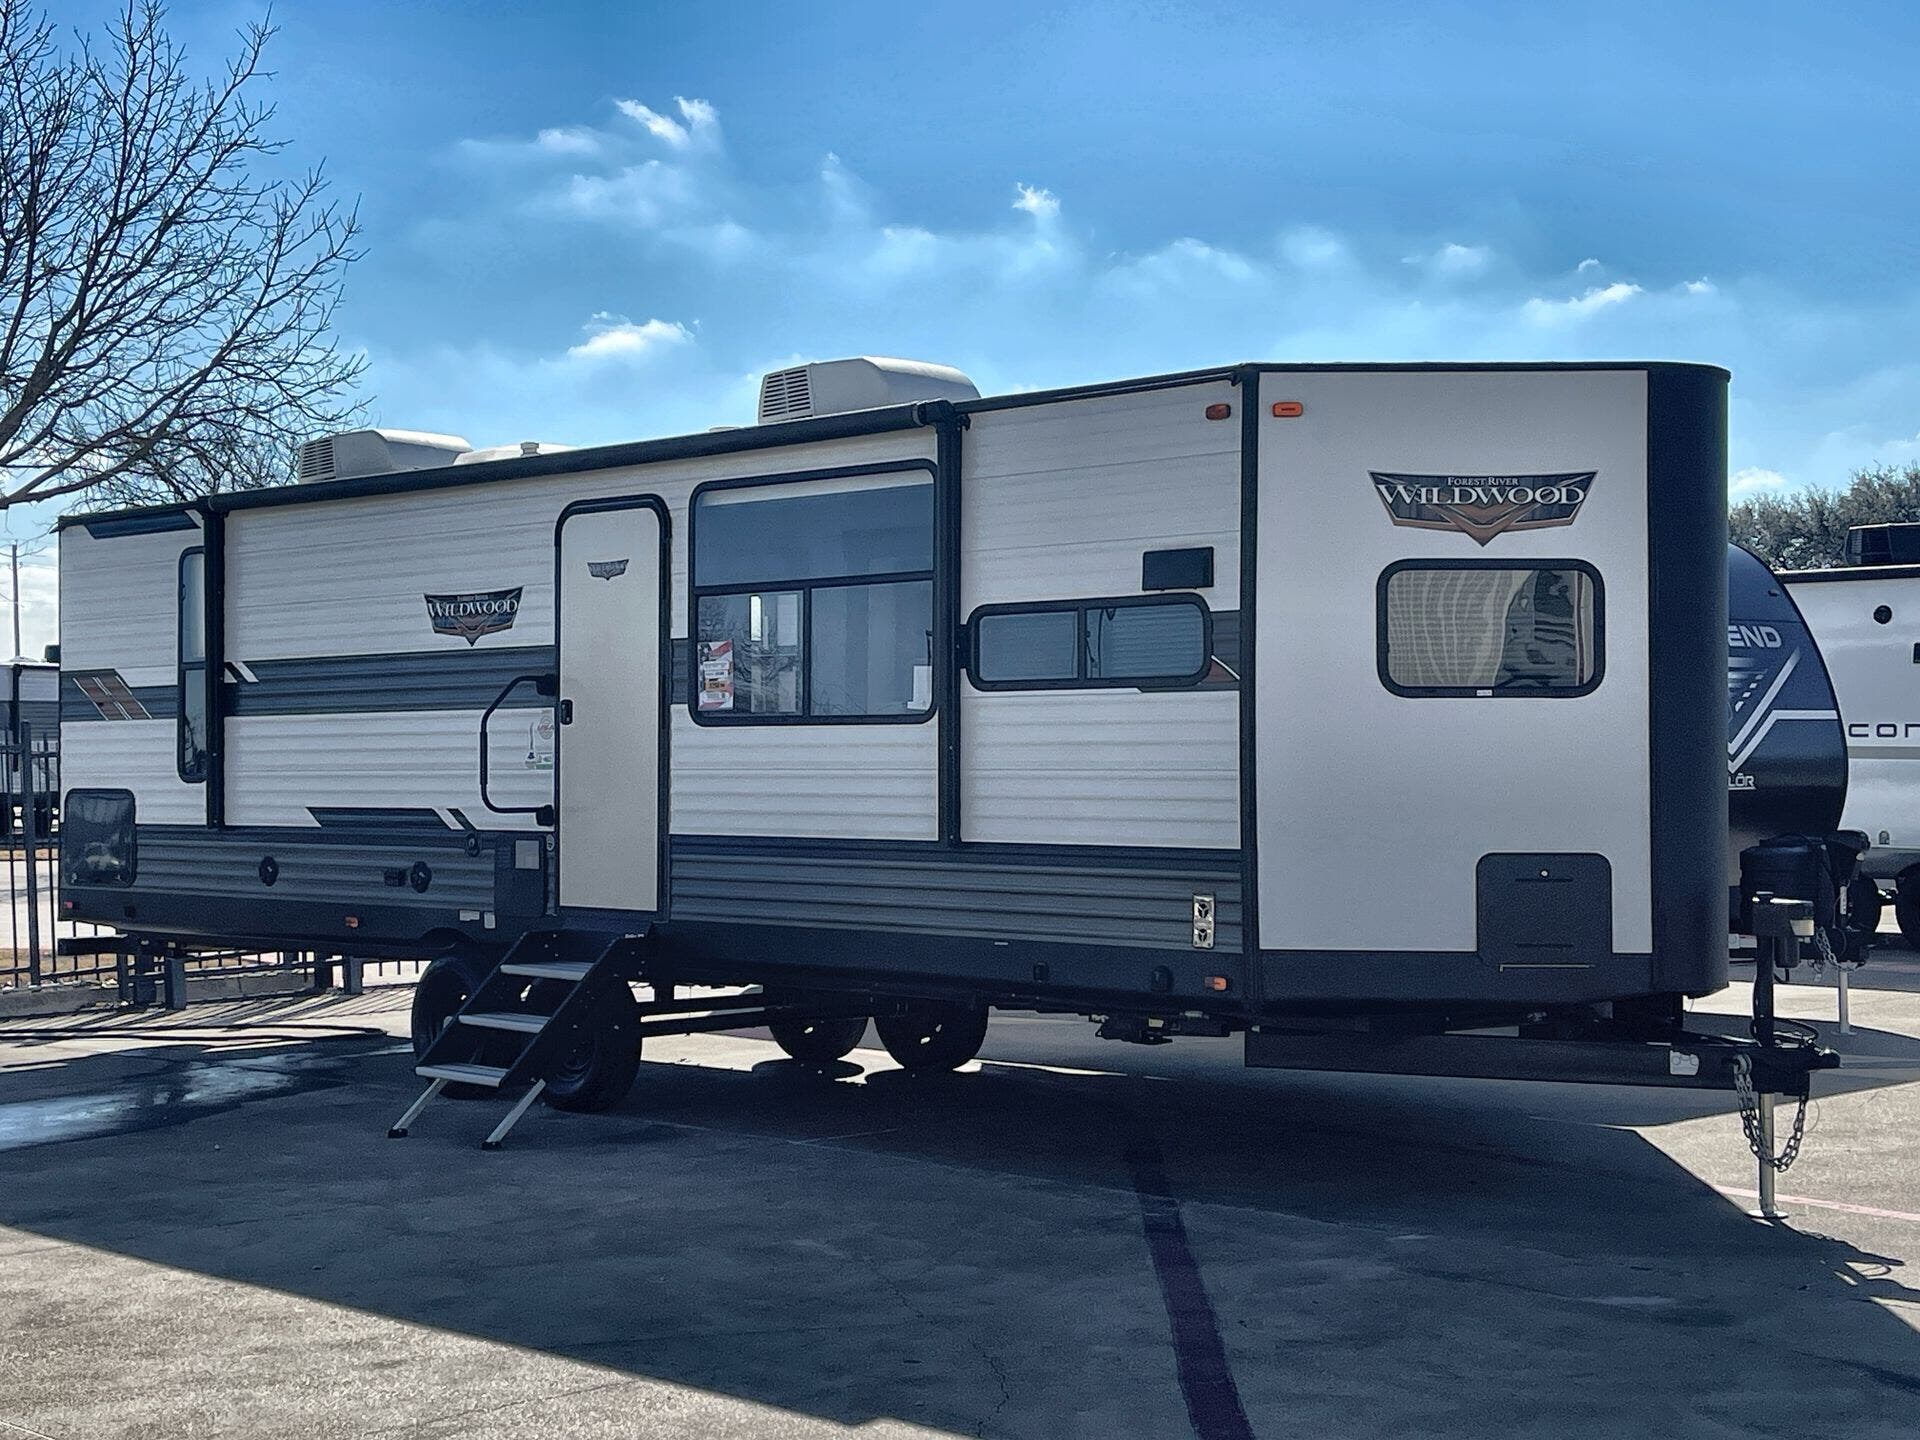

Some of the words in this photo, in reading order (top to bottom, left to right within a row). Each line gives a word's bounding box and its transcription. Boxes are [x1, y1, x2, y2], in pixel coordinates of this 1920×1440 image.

[1447, 476, 1486, 486] FOREST
[1487, 476, 1519, 486] RIVER
[1376, 484, 1585, 505] WILDWOOD
[428, 599, 518, 617] WILDWOOD
[1728, 625, 1782, 648] END
